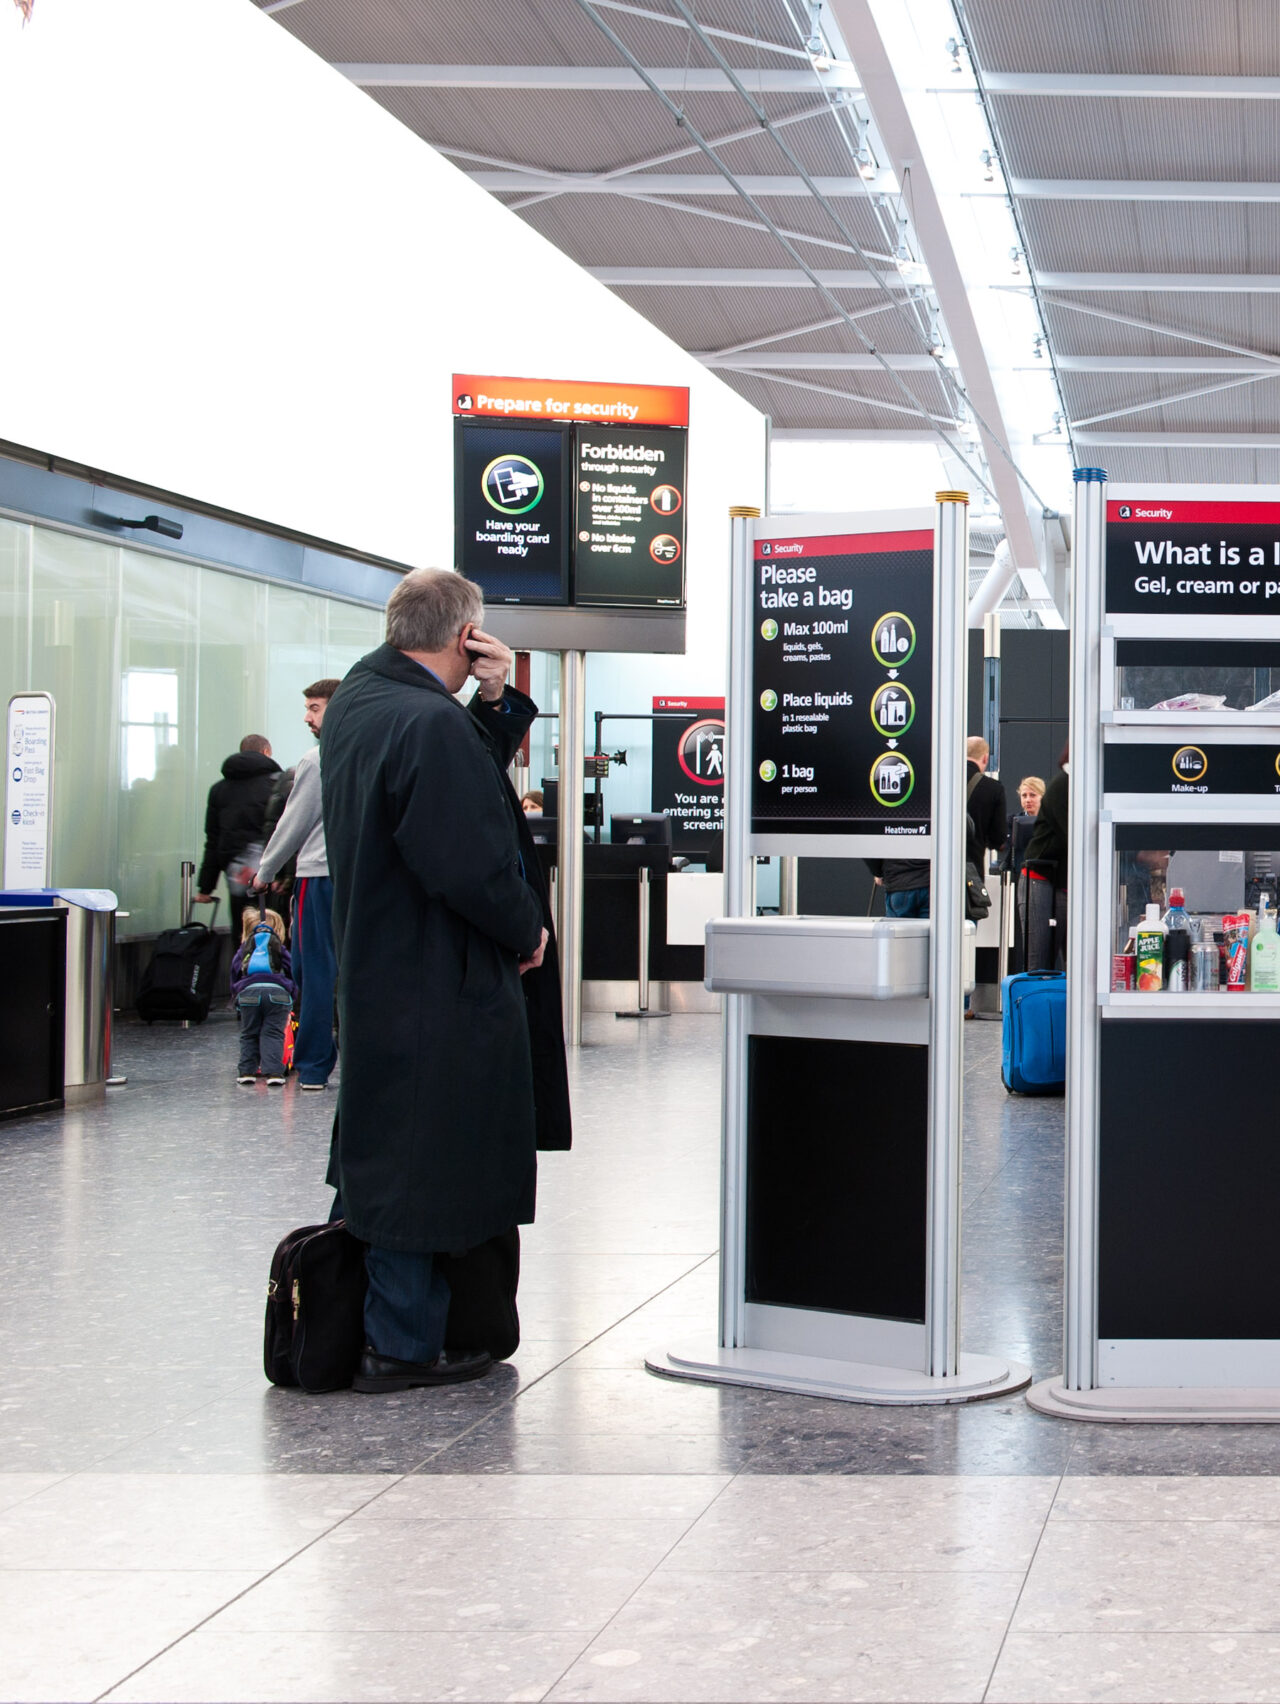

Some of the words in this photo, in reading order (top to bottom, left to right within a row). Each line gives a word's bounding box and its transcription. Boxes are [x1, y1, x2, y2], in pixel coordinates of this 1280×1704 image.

[477, 394, 540, 414] Prepare
[545, 399, 570, 414] for
[574, 402, 638, 420] security
[581, 444, 664, 462] Forbidden
[581, 462, 619, 474] through
[620, 464, 656, 476] security
[591, 483, 606, 493] No
[606, 484, 637, 495] liquids
[591, 493, 601, 502] in
[591, 505, 613, 513] over
[1135, 508, 1173, 519] Security
[486, 520, 512, 531] Have
[515, 522, 540, 532] your
[476, 532, 524, 545] boarding
[527, 532, 550, 544] card
[591, 533, 605, 542] No
[498, 544, 528, 557] ready
[590, 544, 612, 553] over
[612, 544, 632, 553] 6cm
[775, 543, 803, 554] Security
[1135, 541, 1211, 565] What
[1220, 541, 1240, 565] is
[1249, 548, 1264, 565] a
[761, 565, 816, 585] Please
[1134, 577, 1171, 595] Gel,
[1176, 579, 1234, 594] cream
[1239, 580, 1260, 594] or
[760, 588, 798, 608] take
[804, 590, 814, 607] a
[819, 586, 853, 610] bag
[784, 622, 809, 636] Max
[812, 620, 848, 635] 100ml
[783, 642, 807, 652] liquids,
[808, 642, 823, 652] gels,
[783, 653, 808, 663] creams,
[809, 651, 831, 662] pastes
[783, 693, 812, 707] Place
[814, 692, 853, 708] liquids
[782, 713, 789, 722] in
[790, 713, 795, 722] 1
[796, 712, 829, 722] resealable
[782, 723, 802, 734] plastic
[804, 724, 818, 734] bag
[782, 765, 789, 777] 1
[792, 764, 814, 781] bag
[782, 785, 796, 795] per
[796, 784, 817, 794] person
[1172, 784, 1208, 794] Make-up
[675, 794, 696, 803] You
[700, 795, 718, 803] are
[663, 807, 710, 819] entering
[885, 825, 918, 835] Heathrow
[1138, 936, 1160, 946] APPLE
[1139, 943, 1160, 952] JUICE
[1230, 948, 1246, 982] Colgate
